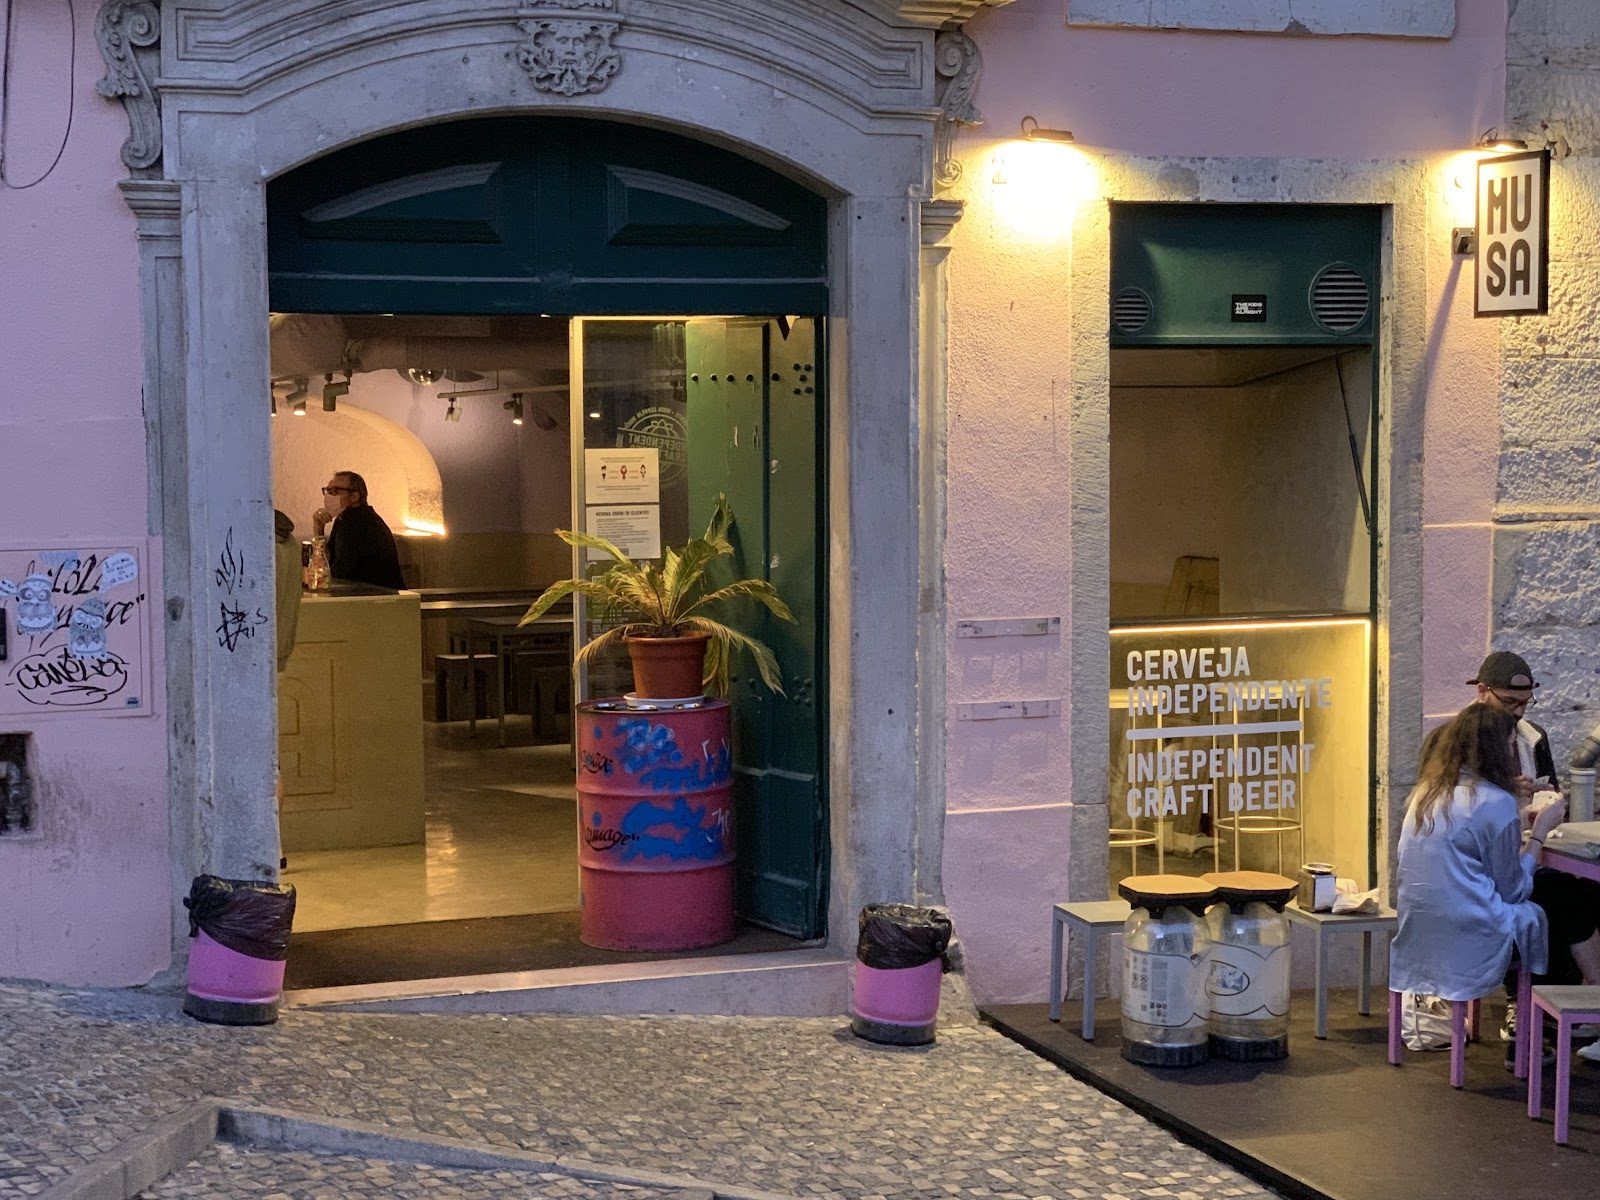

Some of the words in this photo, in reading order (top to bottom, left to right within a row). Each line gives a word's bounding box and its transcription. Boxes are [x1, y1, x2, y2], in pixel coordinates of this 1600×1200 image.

[1487, 174, 1532, 235] MU
[1486, 239, 1531, 297] SA
[1127, 646, 1250, 681] CERVEJA
[1128, 678, 1332, 717] INDEPENDENTE
[1128, 744, 1315, 783] INDEPENDENT
[1127, 784, 1213, 818] CRAFT
[1228, 780, 1295, 812] BEER
